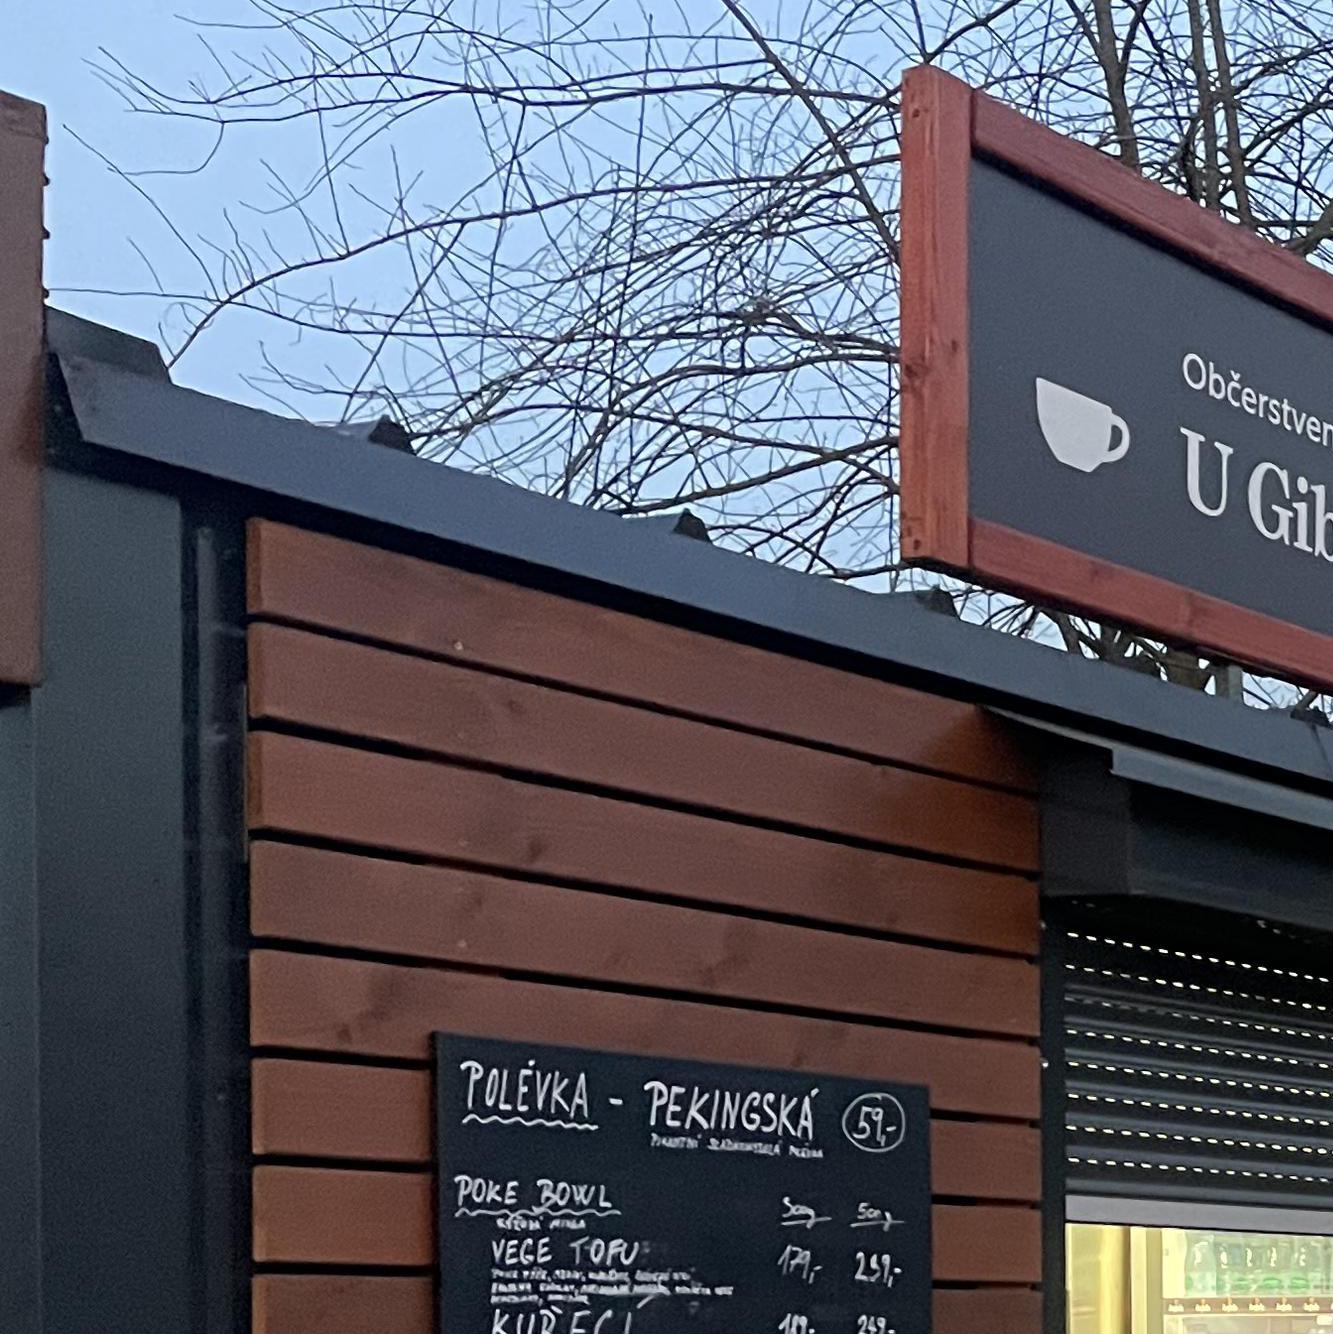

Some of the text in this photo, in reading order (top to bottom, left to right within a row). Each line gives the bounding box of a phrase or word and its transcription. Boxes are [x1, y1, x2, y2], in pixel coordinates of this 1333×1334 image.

[1178, 425, 1233, 517] U
[459, 1059, 590, 1119] POLÉVKA
[643, 1079, 821, 1141] PEKINGSKÁ
[851, 1105, 897, 1147] 59,-
[453, 1174, 613, 1209] POKE BOWL
[491, 1236, 553, 1266] VEGE
[569, 1235, 640, 1266] TOFU
